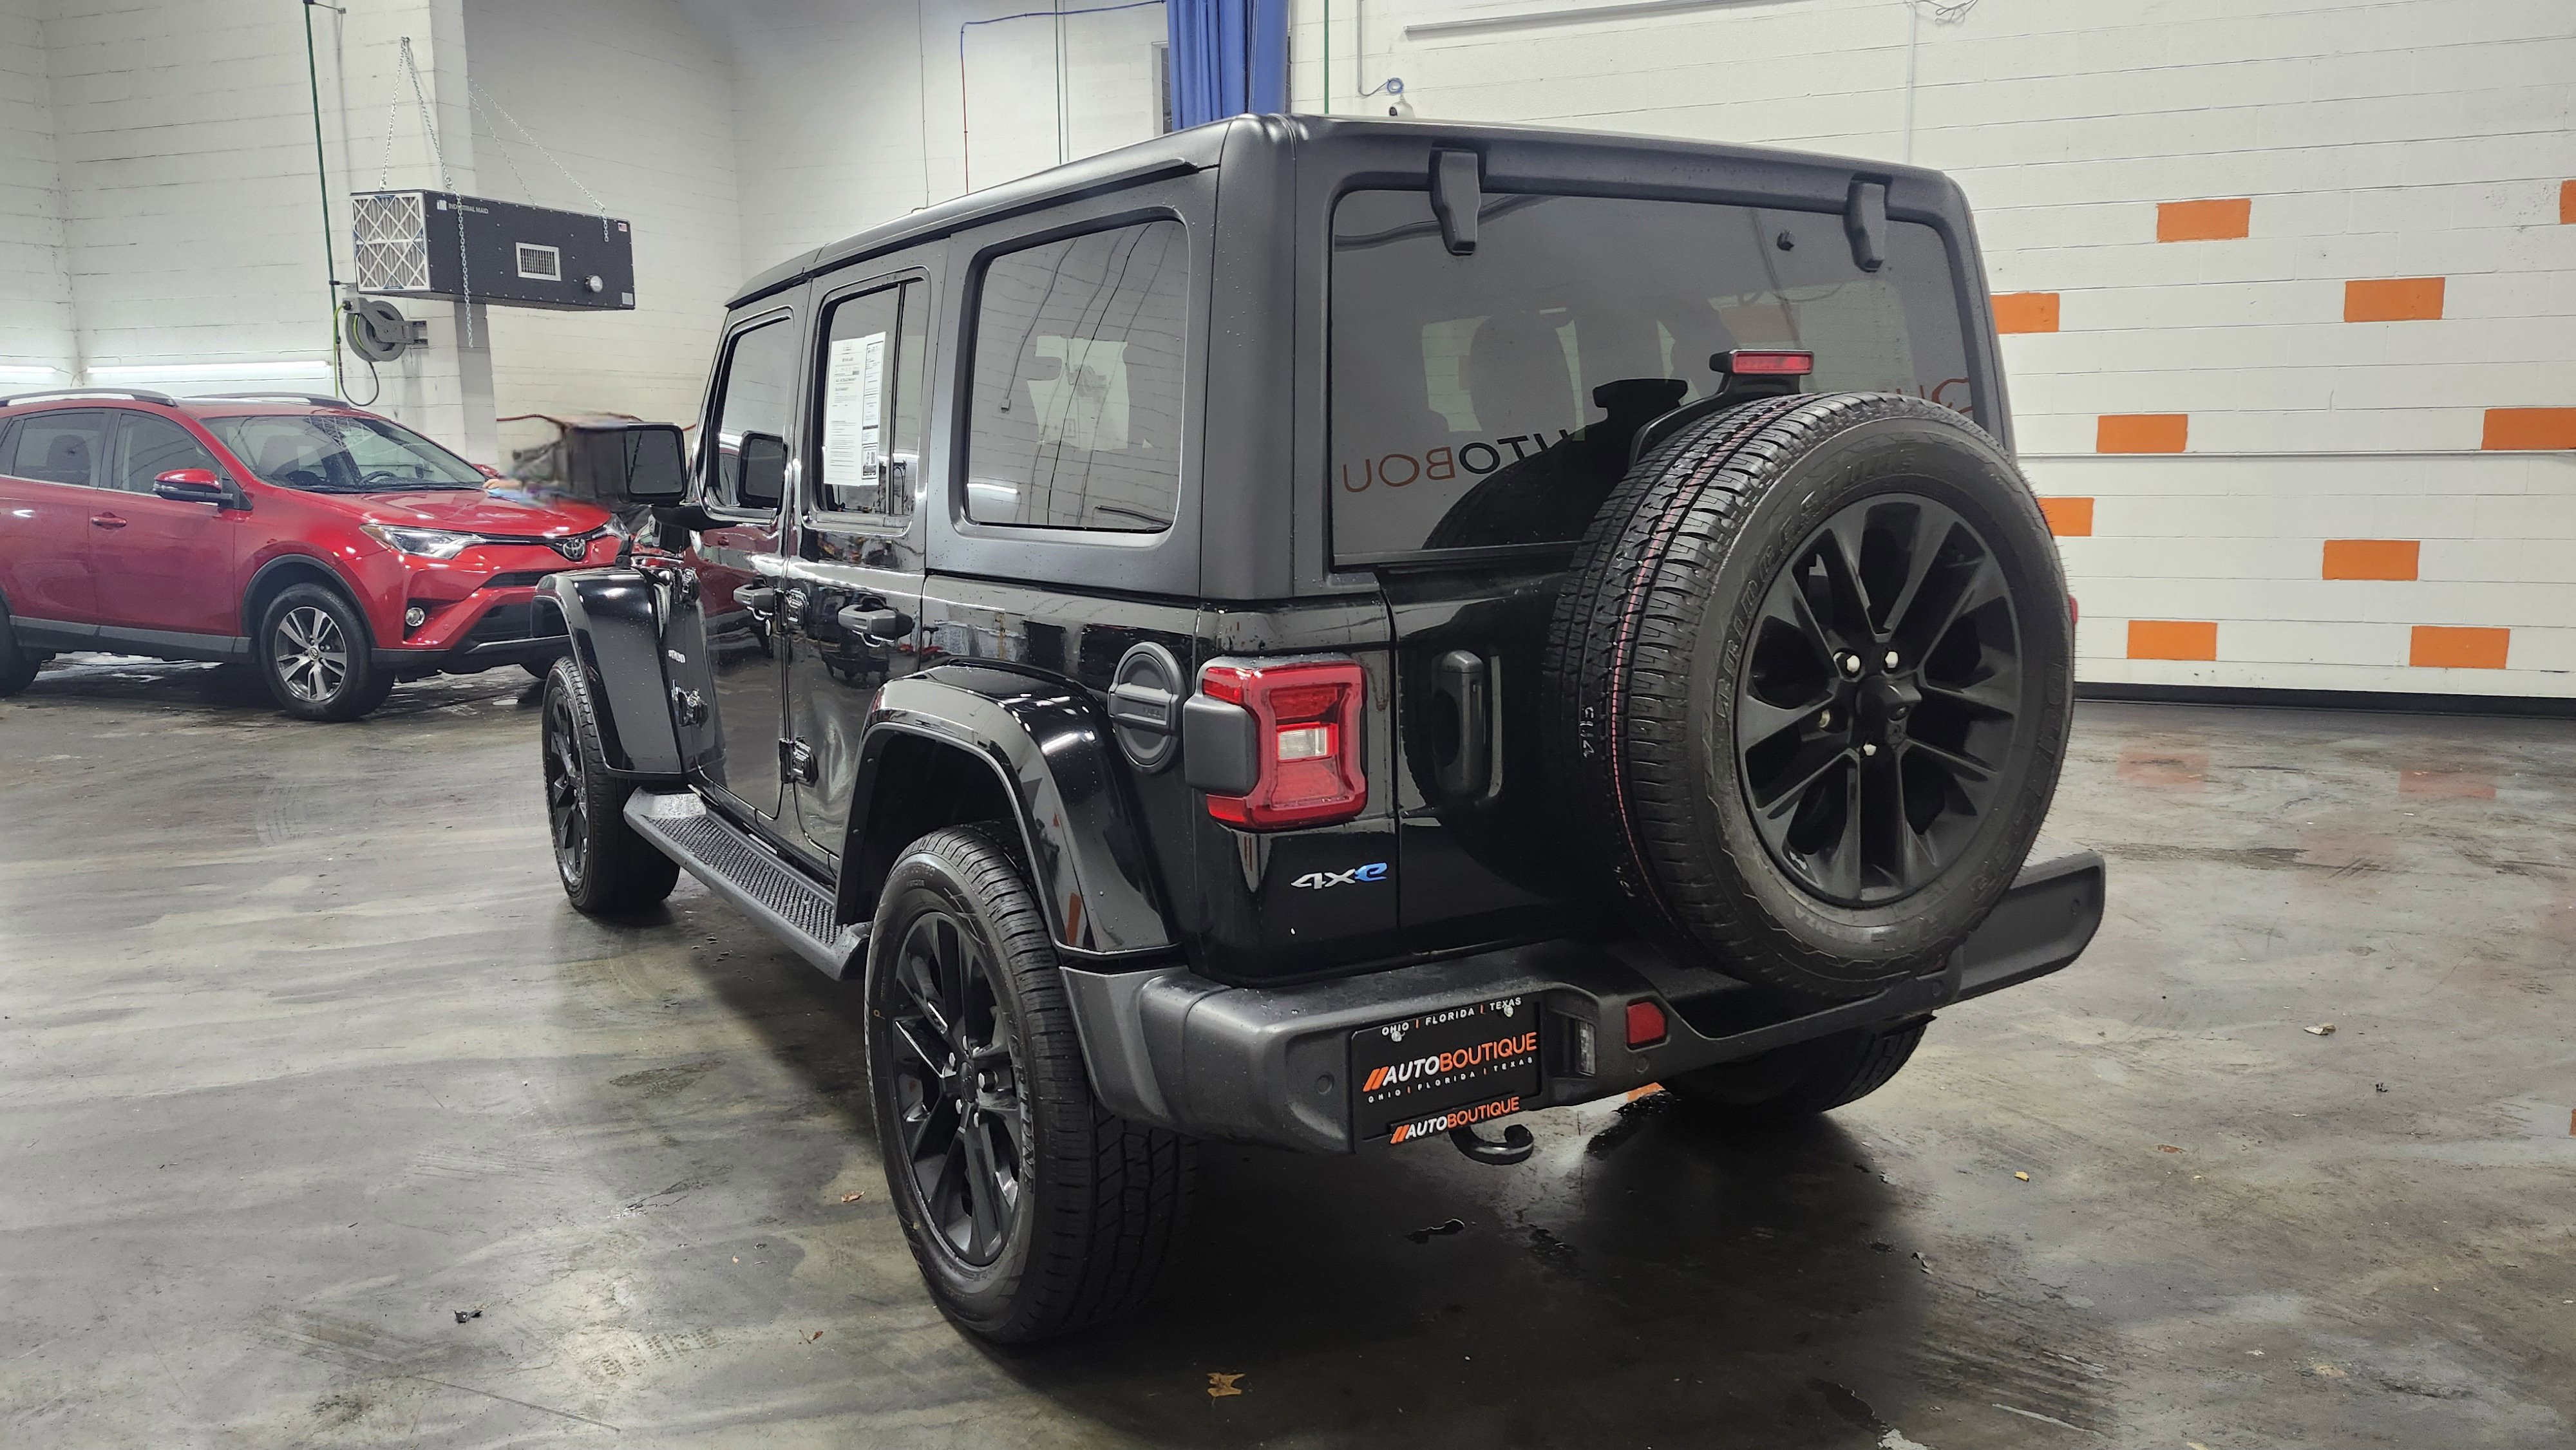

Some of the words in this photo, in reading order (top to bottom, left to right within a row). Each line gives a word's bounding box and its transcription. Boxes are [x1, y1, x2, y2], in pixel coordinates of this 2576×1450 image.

[1381, 1022, 1410, 1036] OHIO
[1425, 1007, 1475, 1026] FLORIDA
[1489, 997, 1522, 1012] TEXAS
[1368, 1089, 1401, 1104] OHIO
[1417, 1071, 1476, 1092] FLORIDA
[1493, 1056, 1533, 1072] TEXAS
[1382, 1031, 1538, 1086] AUTOBOUTIQUE
[1405, 1096, 1520, 1140] AUTOBOUTIQUE
